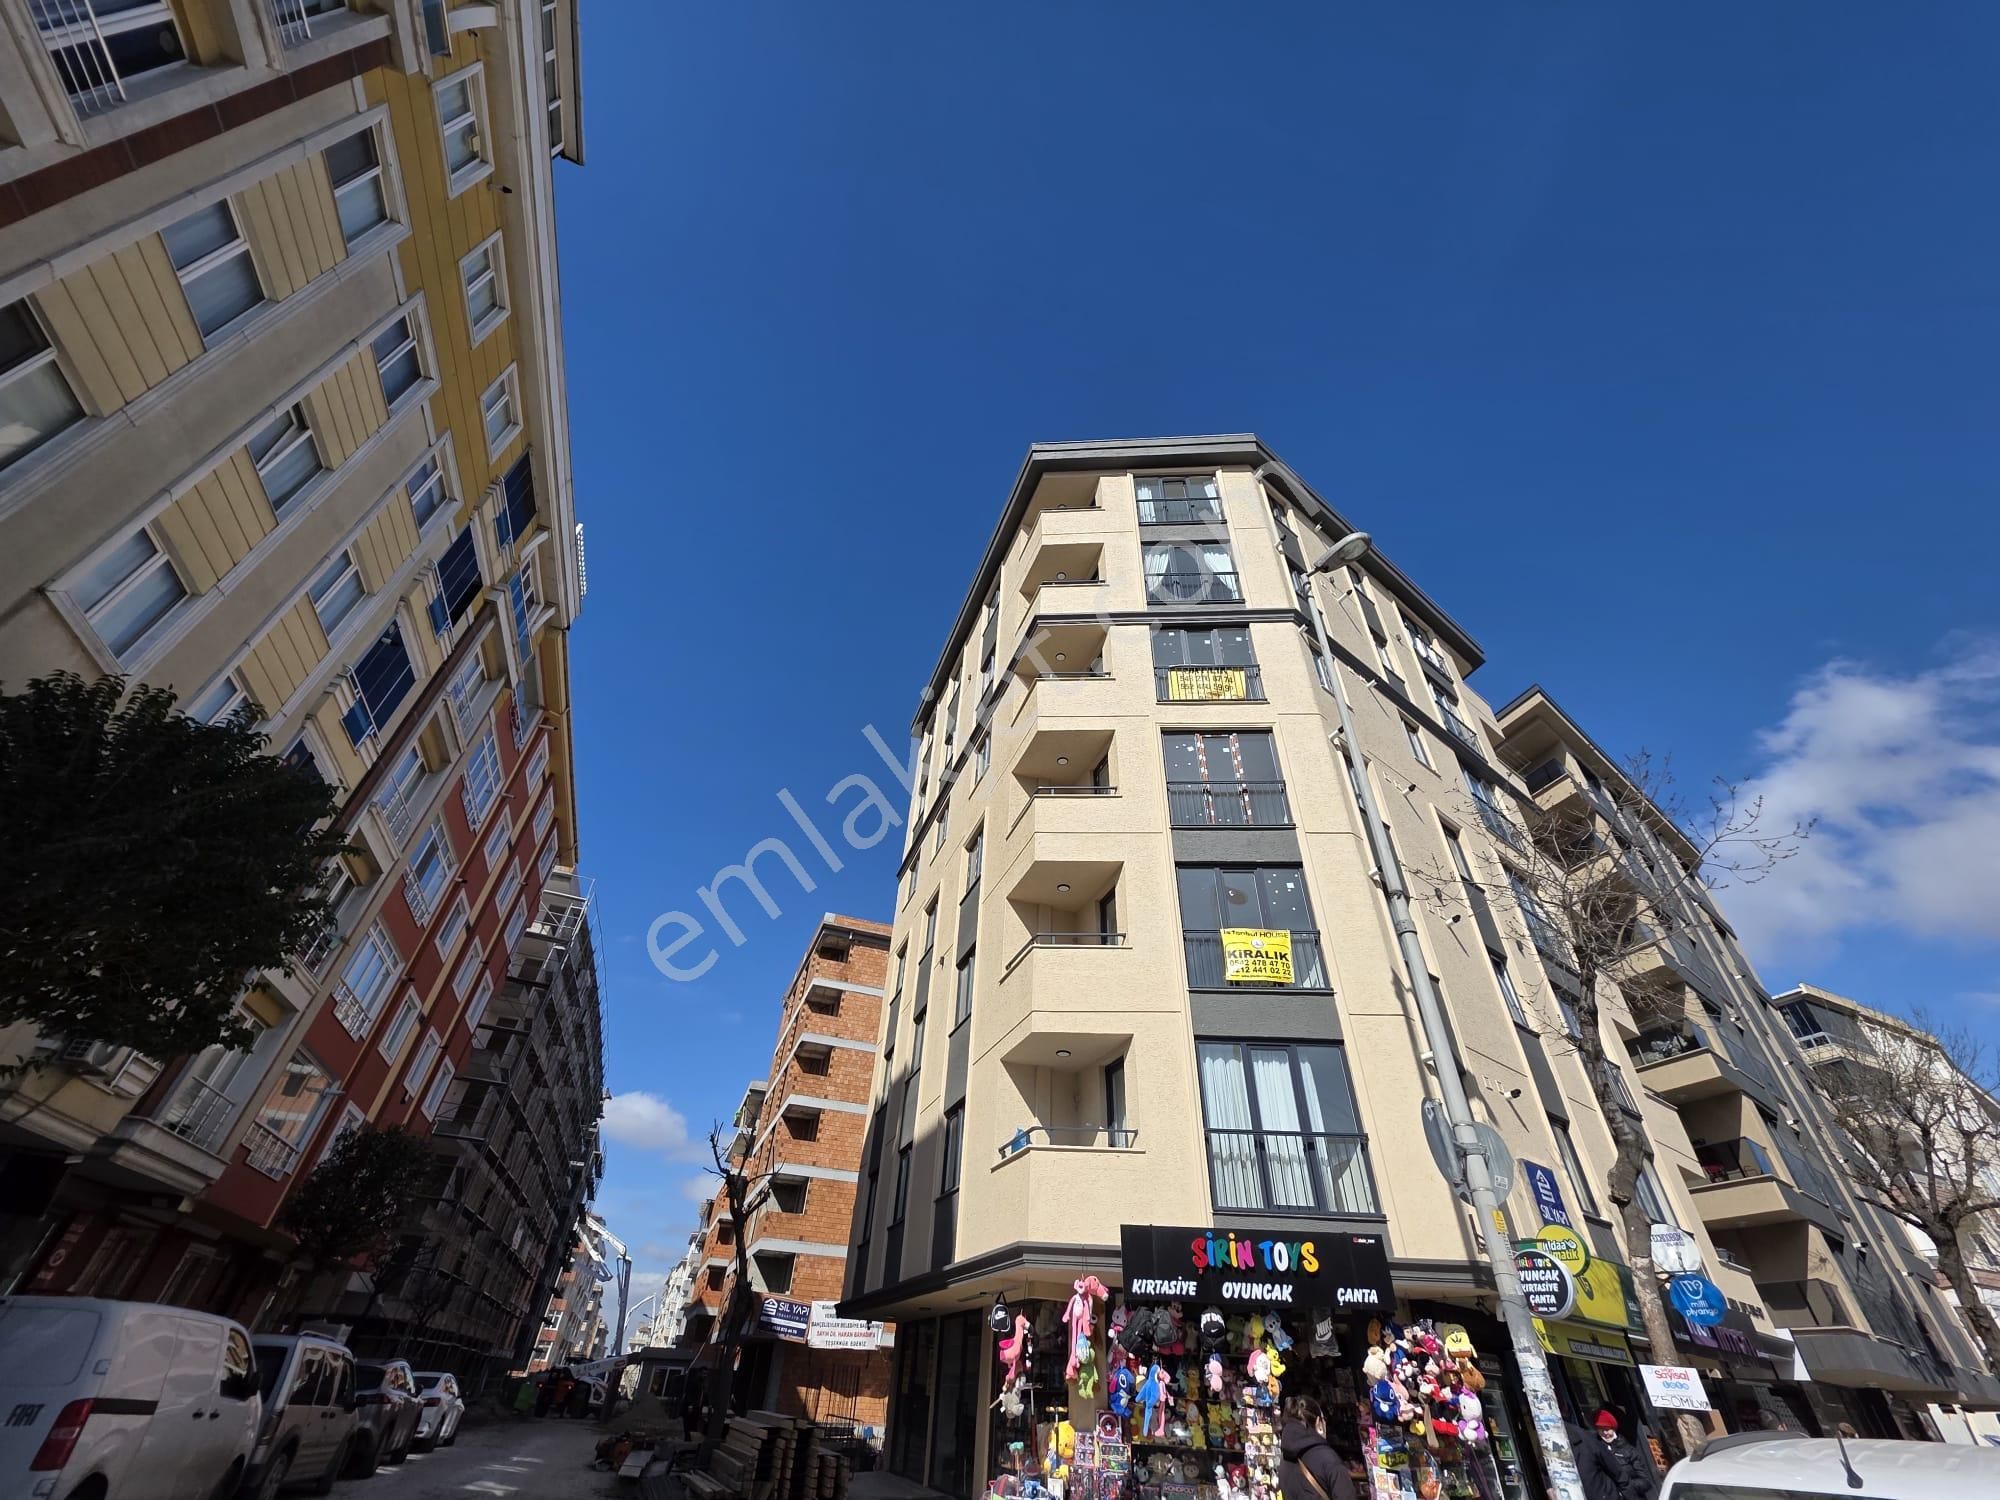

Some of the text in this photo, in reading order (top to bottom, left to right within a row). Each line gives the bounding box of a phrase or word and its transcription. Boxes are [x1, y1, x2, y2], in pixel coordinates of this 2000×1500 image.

[1251, 959, 1267, 967] 478
[1252, 966, 1267, 974] 441
[1282, 968, 1292, 977] 22
[1191, 1232, 1320, 1274] ŞİRİN TOYS
[1519, 1269, 1560, 1282] YUNCAK
[1132, 1276, 1378, 1305] KIRTASİYE OYUNCAK ÇANTA
[1529, 1294, 1557, 1306] ÇANTA
[793, 1304, 810, 1316] YAPI
[4, 1403, 46, 1428] FIAT
